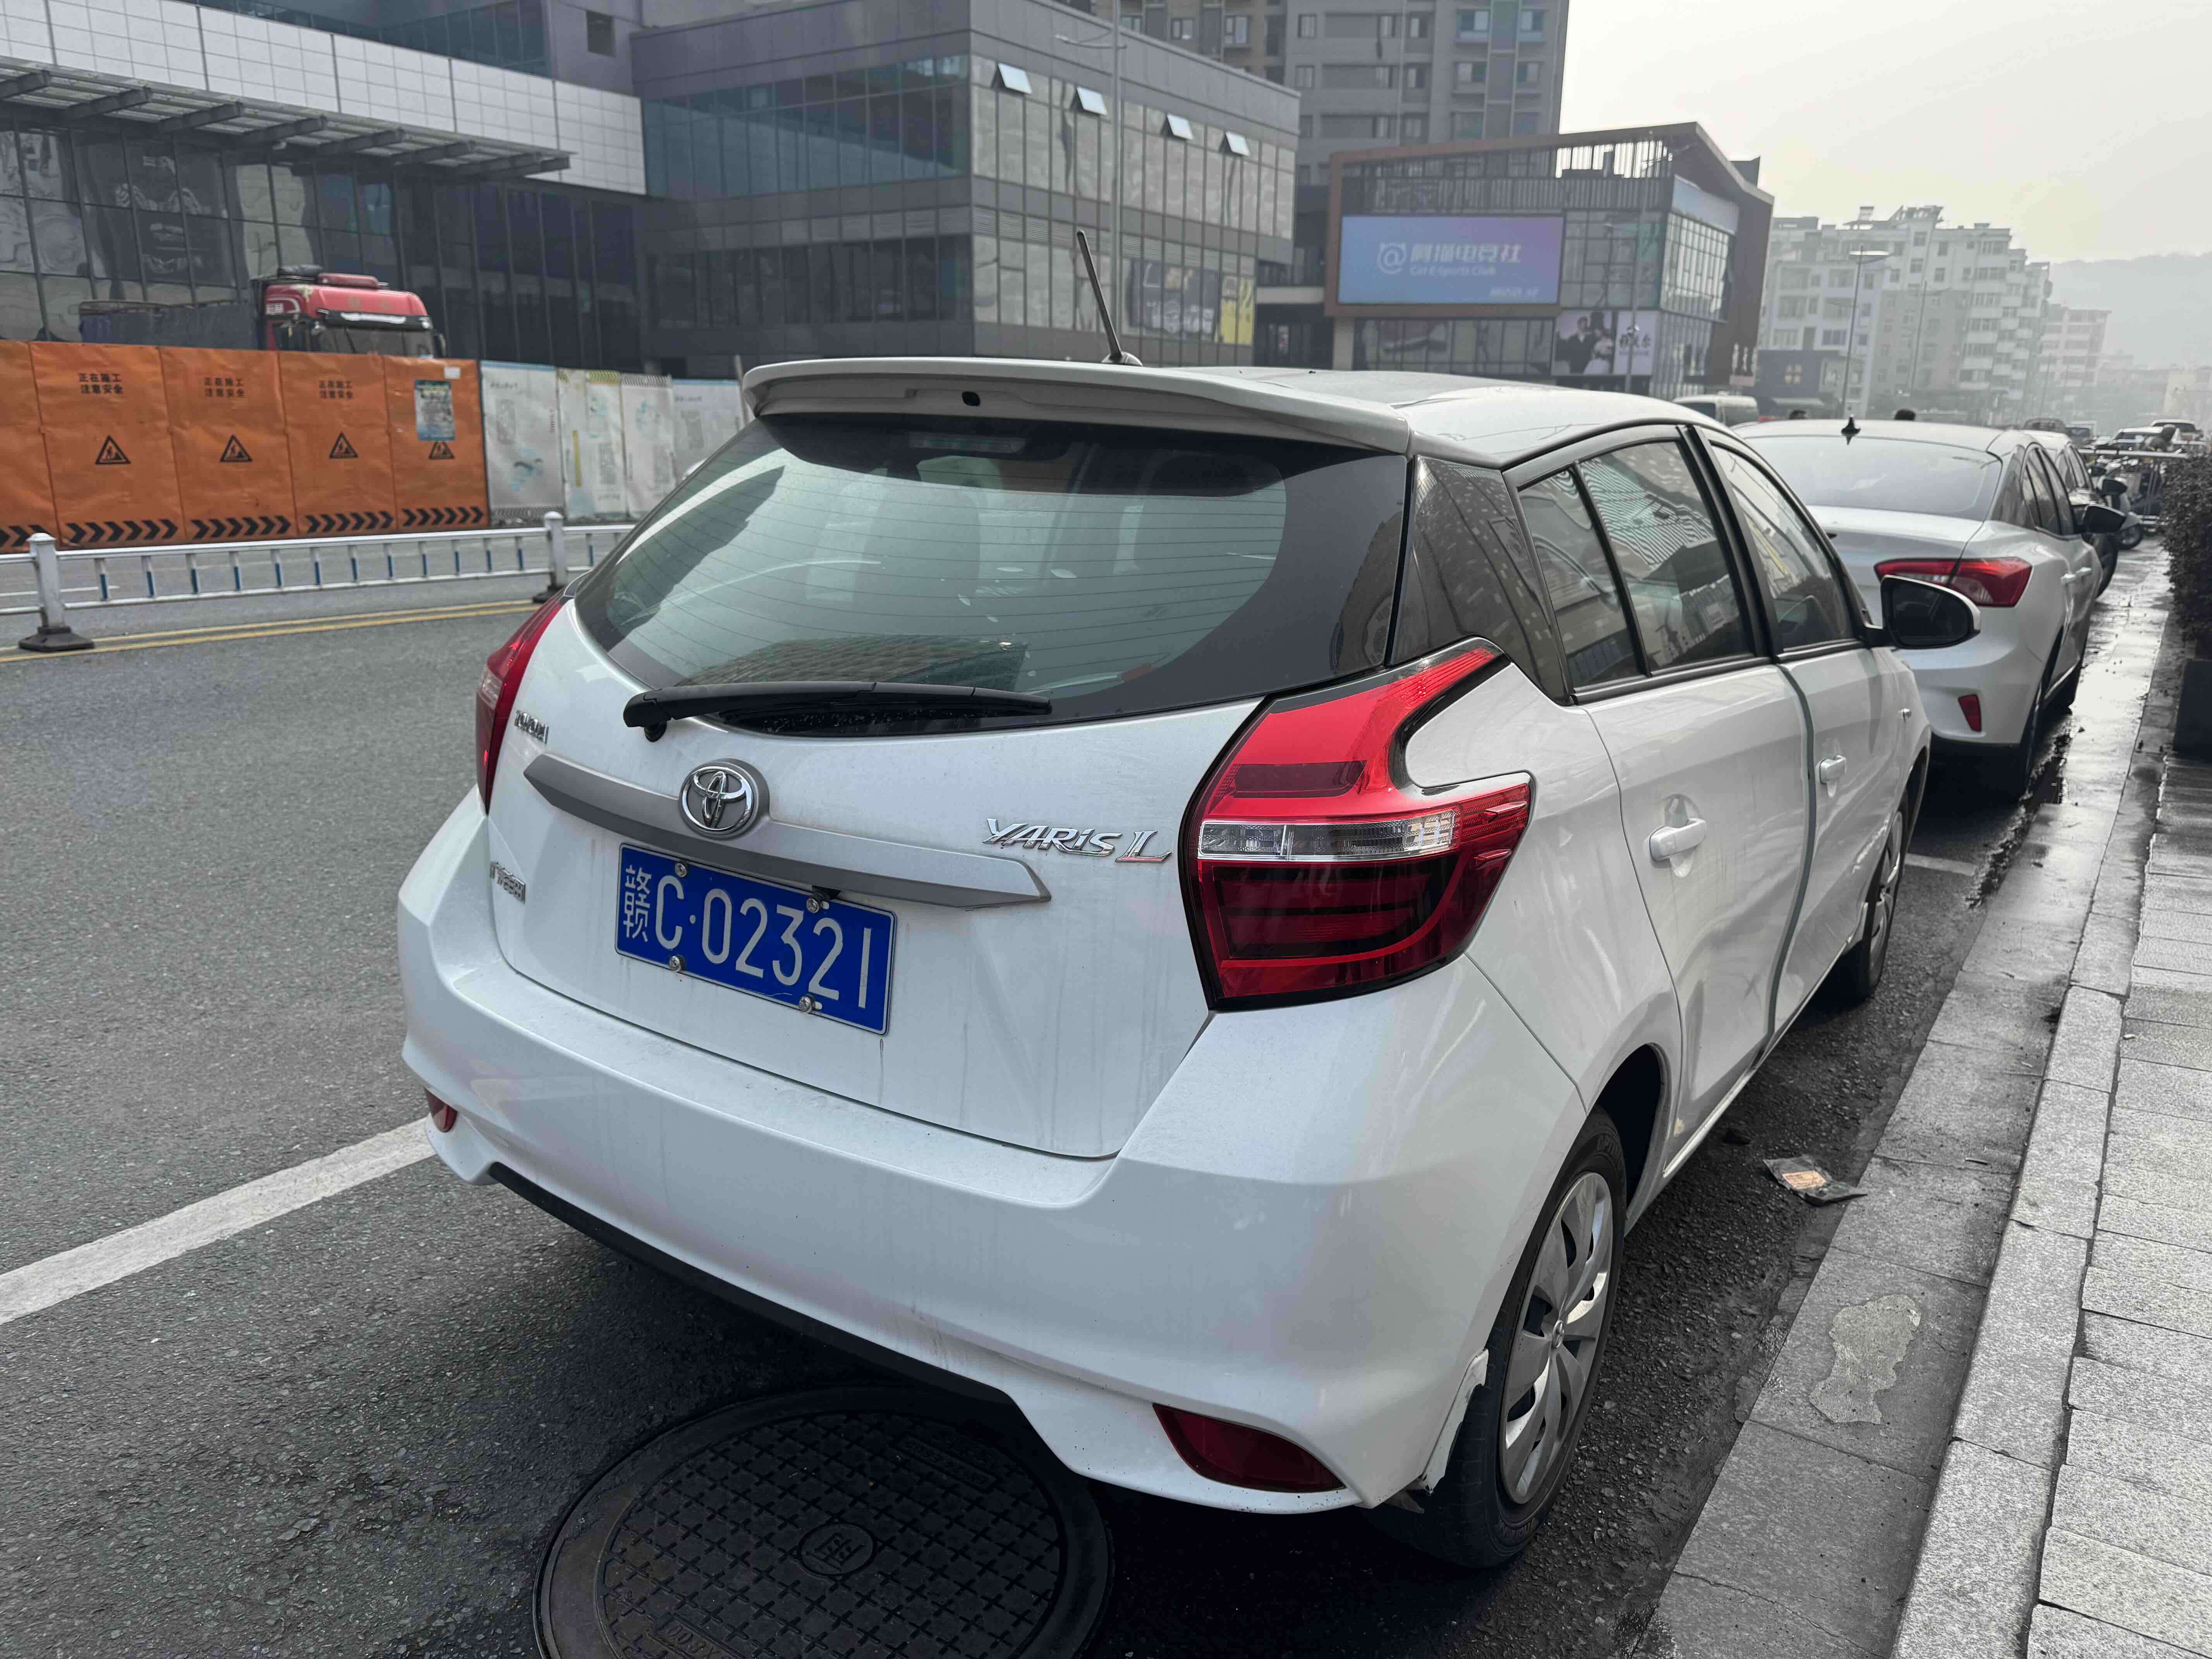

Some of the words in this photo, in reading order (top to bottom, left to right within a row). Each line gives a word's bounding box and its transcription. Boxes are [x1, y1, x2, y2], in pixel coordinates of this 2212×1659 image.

[79, 373, 122, 383] 正在施工
[204, 378, 244, 387] 正在施工
[81, 384, 124, 394] 注意安全
[204, 388, 245, 397] 注意安全
[1115, 830, 1172, 863] L
